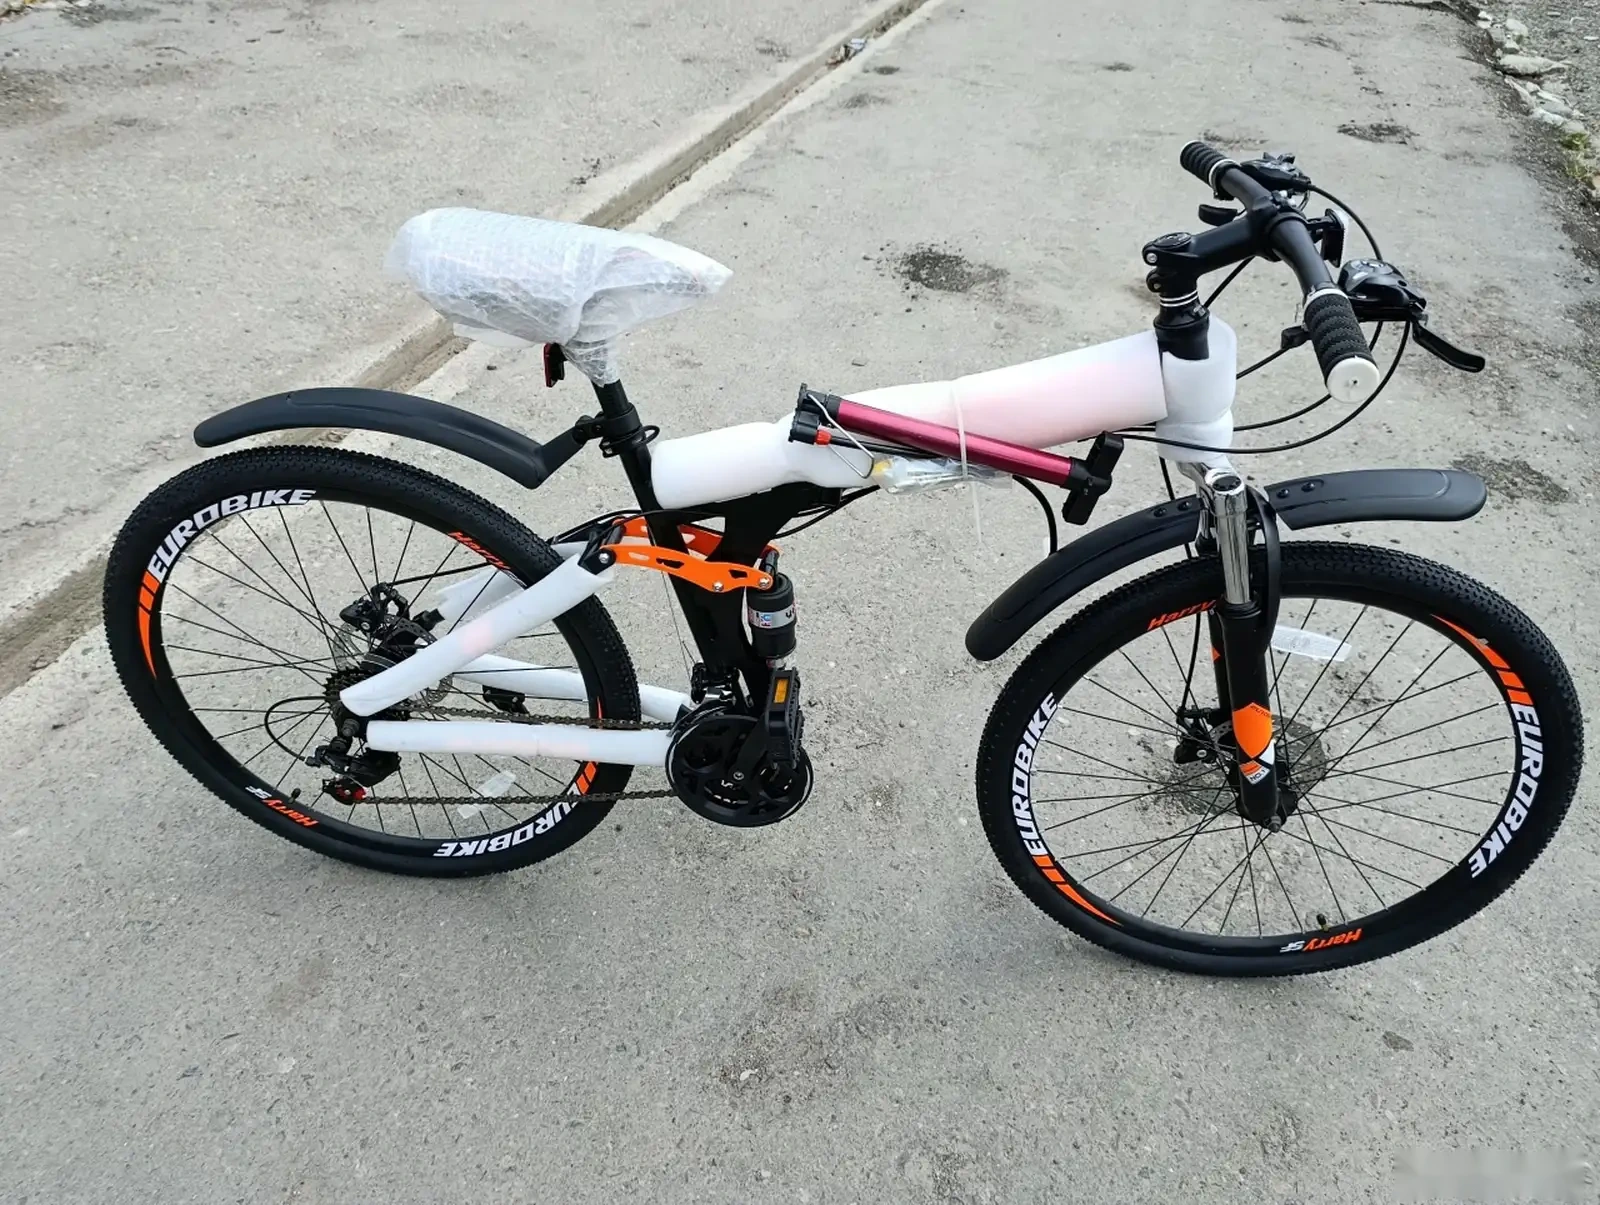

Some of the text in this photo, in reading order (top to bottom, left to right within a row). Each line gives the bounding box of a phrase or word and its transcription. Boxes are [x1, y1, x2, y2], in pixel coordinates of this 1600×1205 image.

[147, 489, 317, 584] EUROBIKE
[1012, 692, 1058, 856] EUROBIKE
[1468, 703, 1544, 878] EUROBIKE
